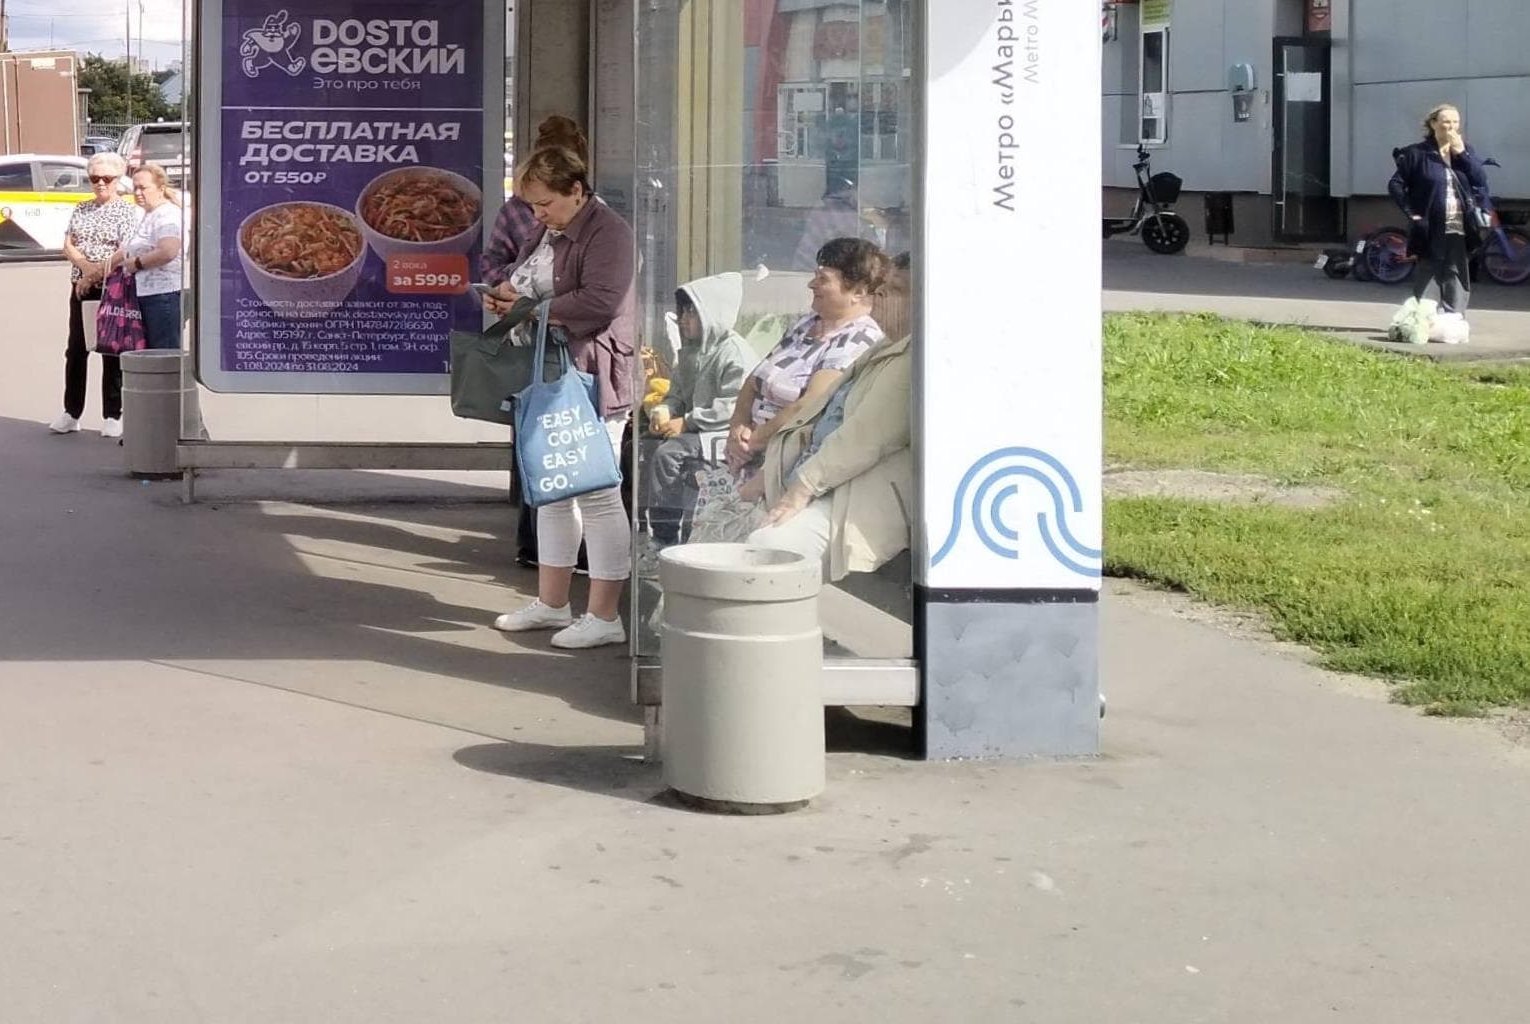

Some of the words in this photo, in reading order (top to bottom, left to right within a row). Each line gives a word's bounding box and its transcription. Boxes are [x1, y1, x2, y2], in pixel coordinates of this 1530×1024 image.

[1023, 25, 1039, 84] Metro
[313, 77, 344, 89] Это
[347, 80, 379, 92] про
[382, 78, 421, 90] тебя
[240, 120, 461, 141] БЕСПЛАТНАЯ
[239, 144, 420, 166] ДОСТАВКА
[993, 114, 1020, 213] Метро
[244, 171, 272, 183] ОТ
[393, 260, 400, 269] 2
[393, 276, 412, 286] за
[423, 310, 449, 320] ООО
[325, 320, 355, 329] ОГРН
[443, 360, 452, 373] 1
[548, 421, 601, 447] COME,
[542, 445, 588, 470] EASY
